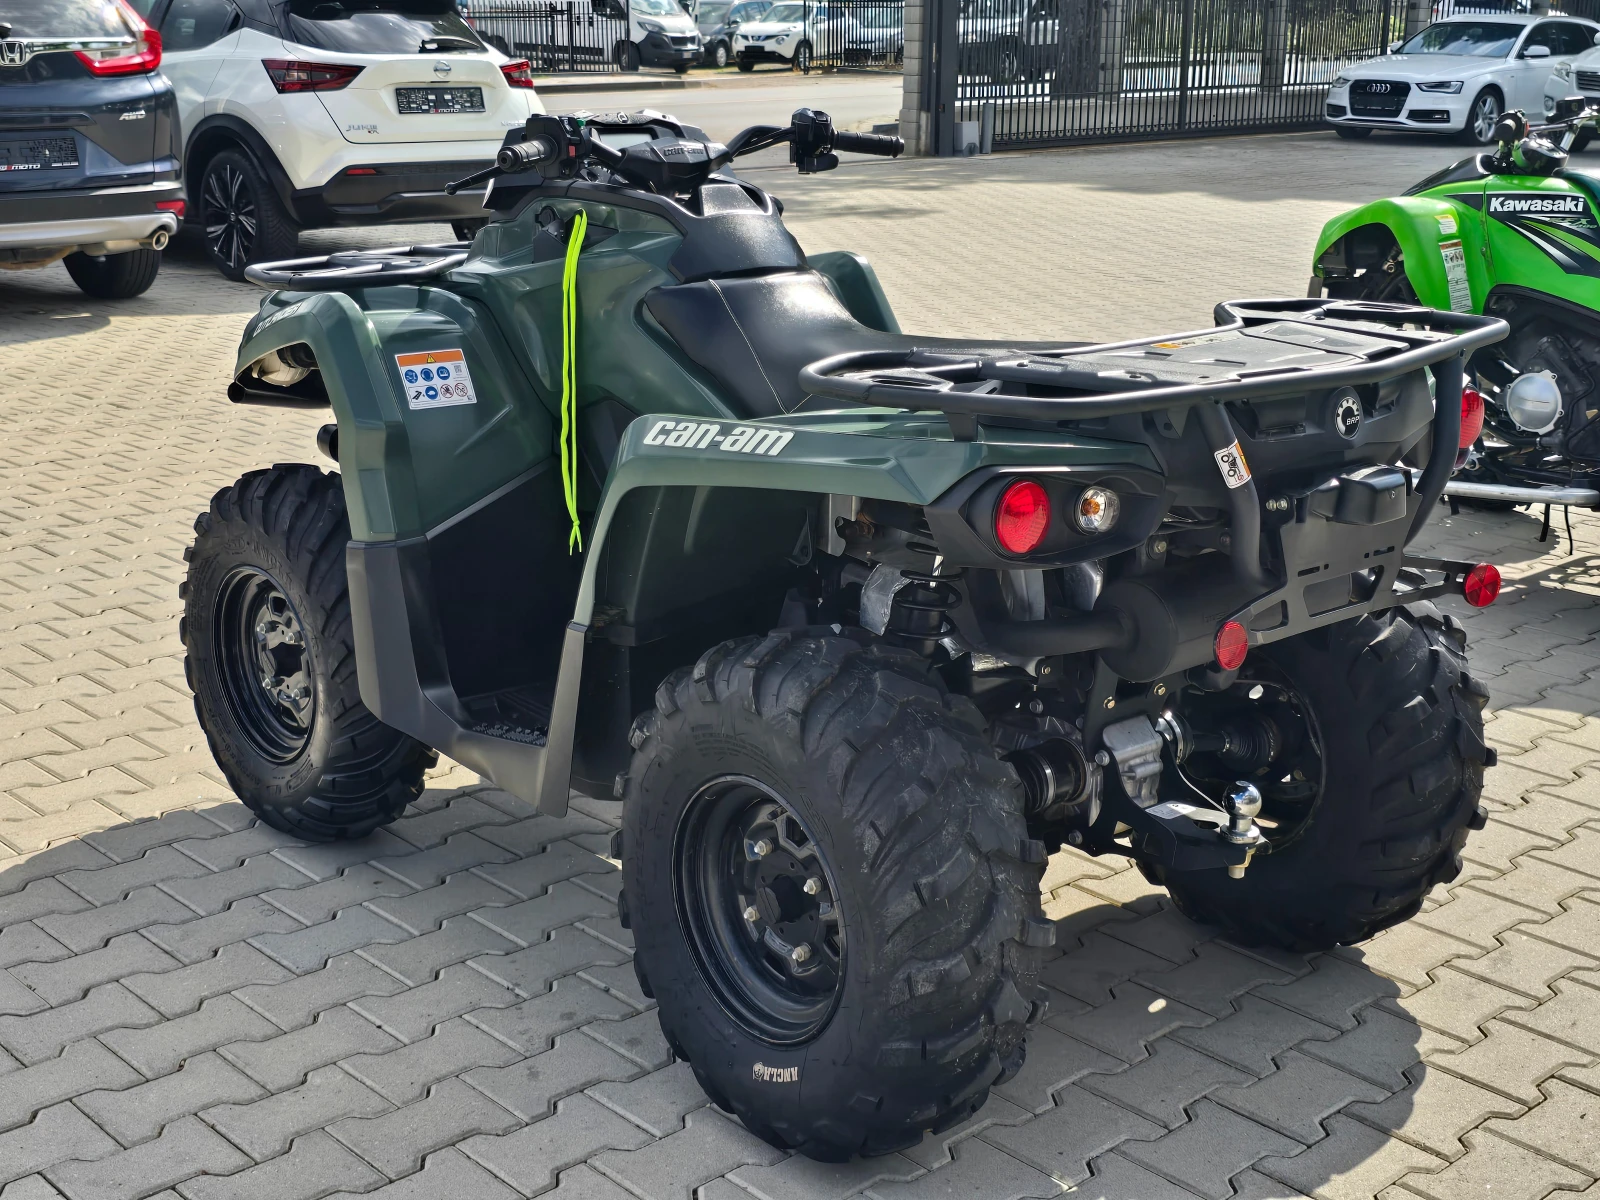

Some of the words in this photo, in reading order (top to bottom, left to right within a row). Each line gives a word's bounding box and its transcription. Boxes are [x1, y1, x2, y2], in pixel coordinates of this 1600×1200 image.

[1489, 197, 1584, 212] Kawasaki
[1346, 415, 1360, 426] BRP
[643, 420, 795, 457] can-am
[763, 1066, 799, 1082] ANCLA
